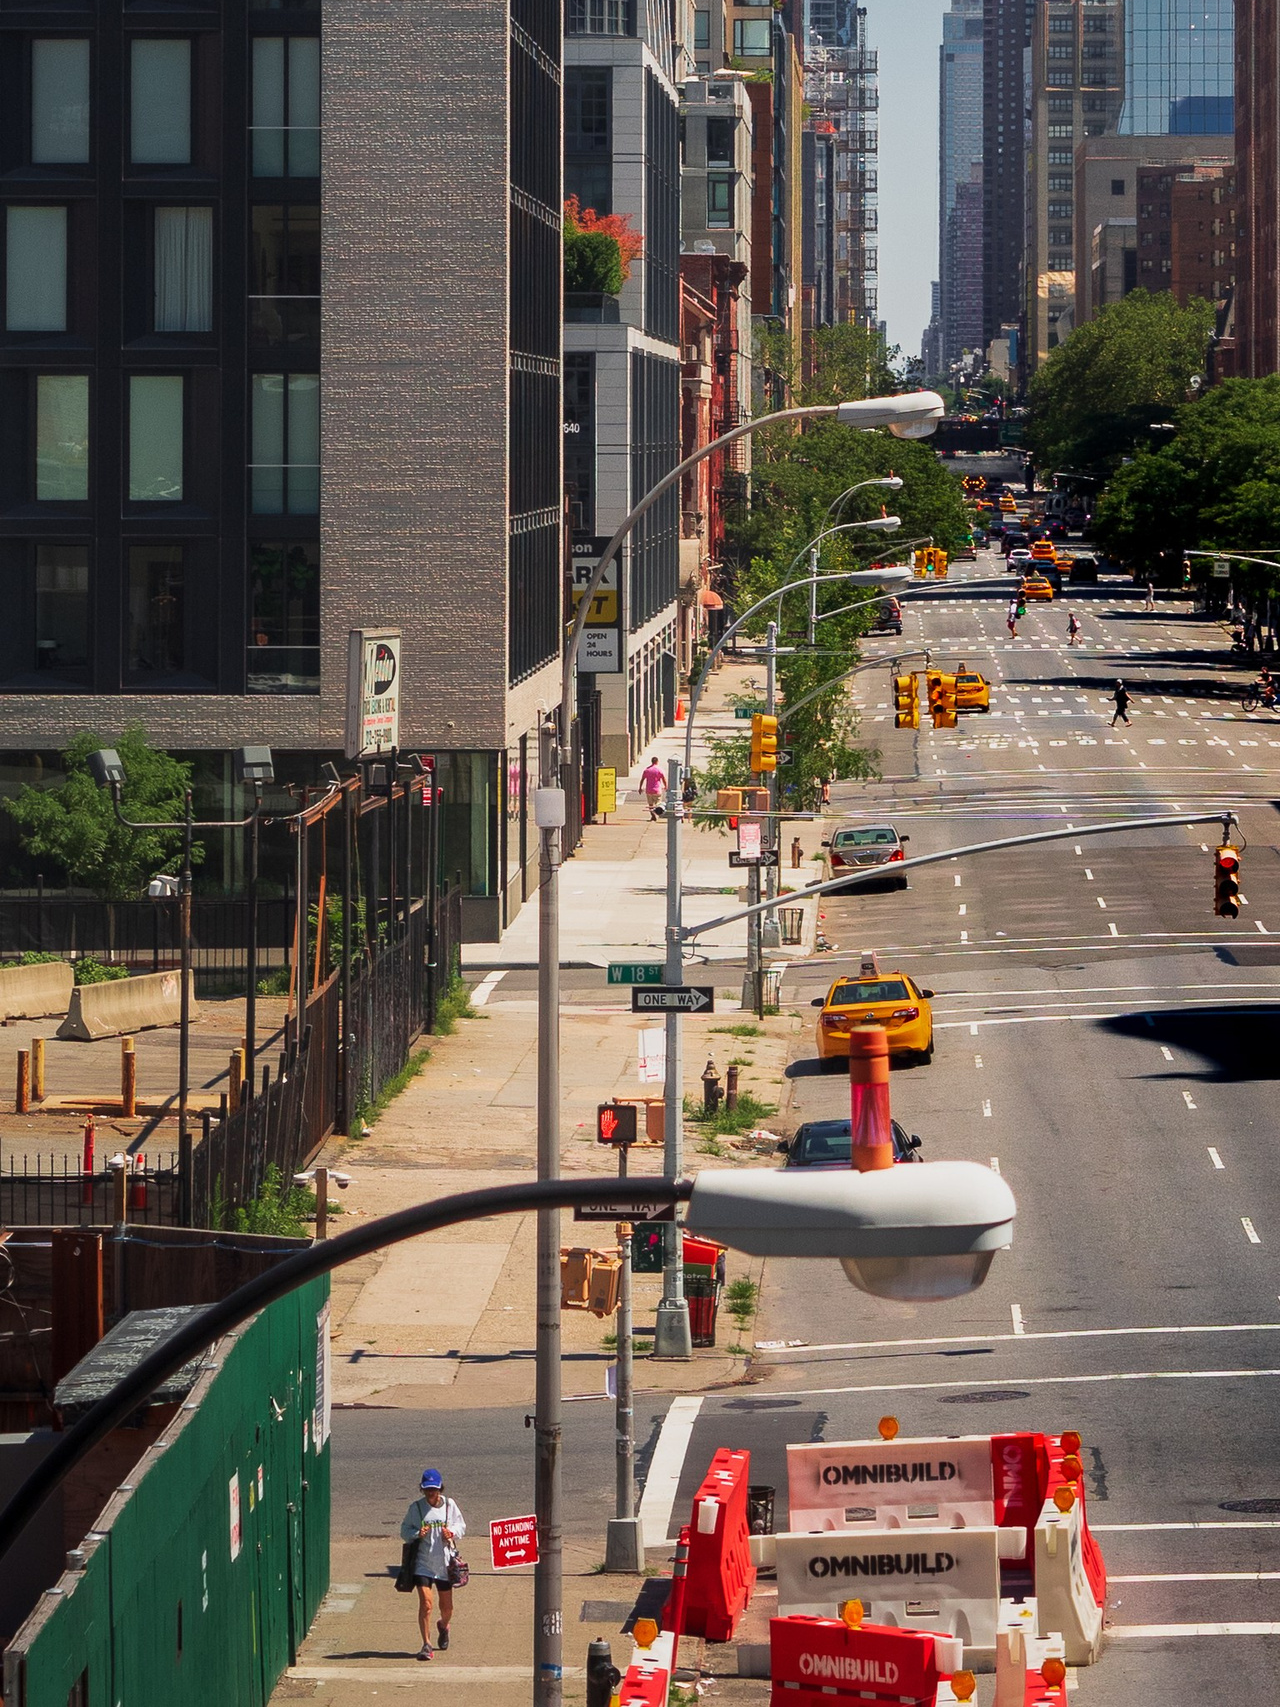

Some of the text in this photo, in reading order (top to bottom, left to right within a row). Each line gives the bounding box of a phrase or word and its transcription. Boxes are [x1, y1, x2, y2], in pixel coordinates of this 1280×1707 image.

[737, 709, 744, 718] W
[611, 966, 659, 982] W 18 ST
[643, 994, 701, 1005] ONE WAY
[822, 1461, 957, 1486] OMNIBUILD
[493, 1520, 535, 1536] NO STANDING
[499, 1534, 531, 1548] ANYTIME
[808, 1551, 955, 1578] OMNIBUILD
[799, 1651, 900, 1685] OMNIBUILD
